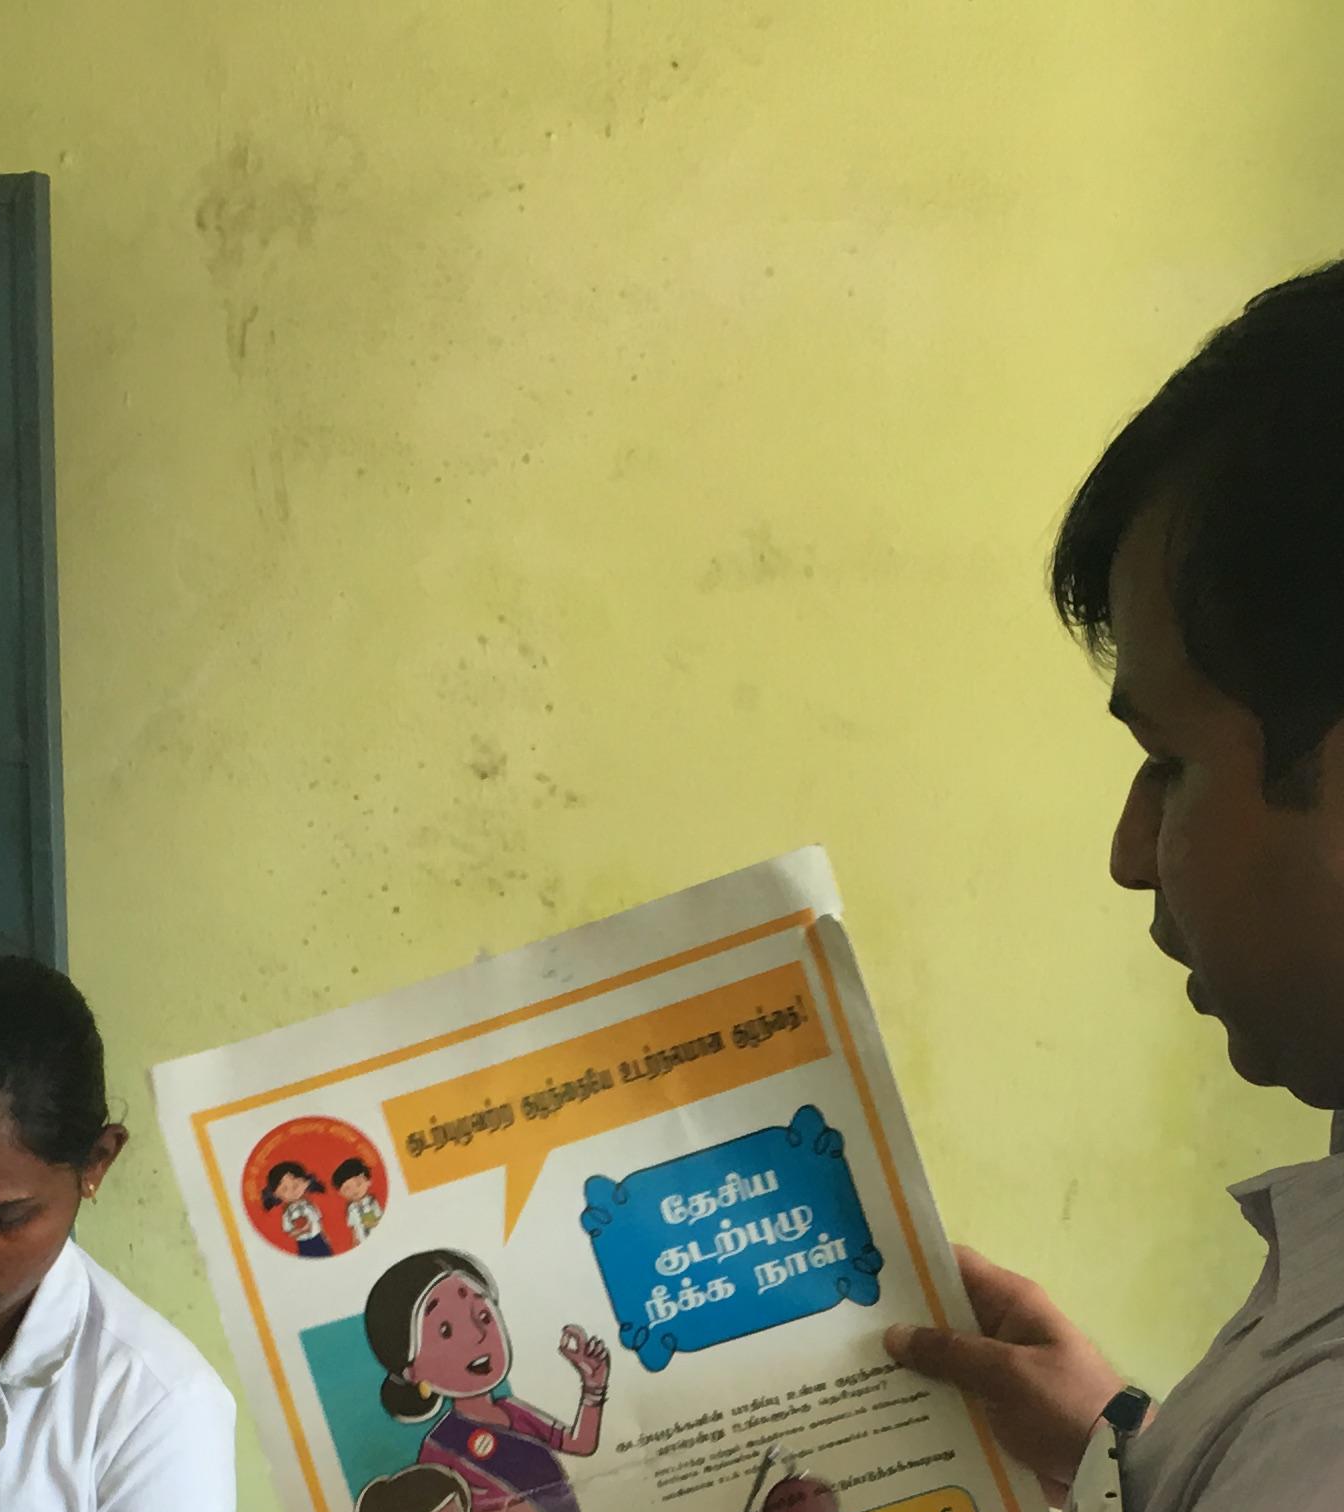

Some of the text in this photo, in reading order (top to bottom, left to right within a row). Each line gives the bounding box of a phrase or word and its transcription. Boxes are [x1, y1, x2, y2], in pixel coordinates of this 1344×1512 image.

[660, 1169, 780, 1225] தேசிய
[655, 1205, 814, 1276] குடற்புழு
[645, 1232, 849, 1329] நீக்க நாள்
